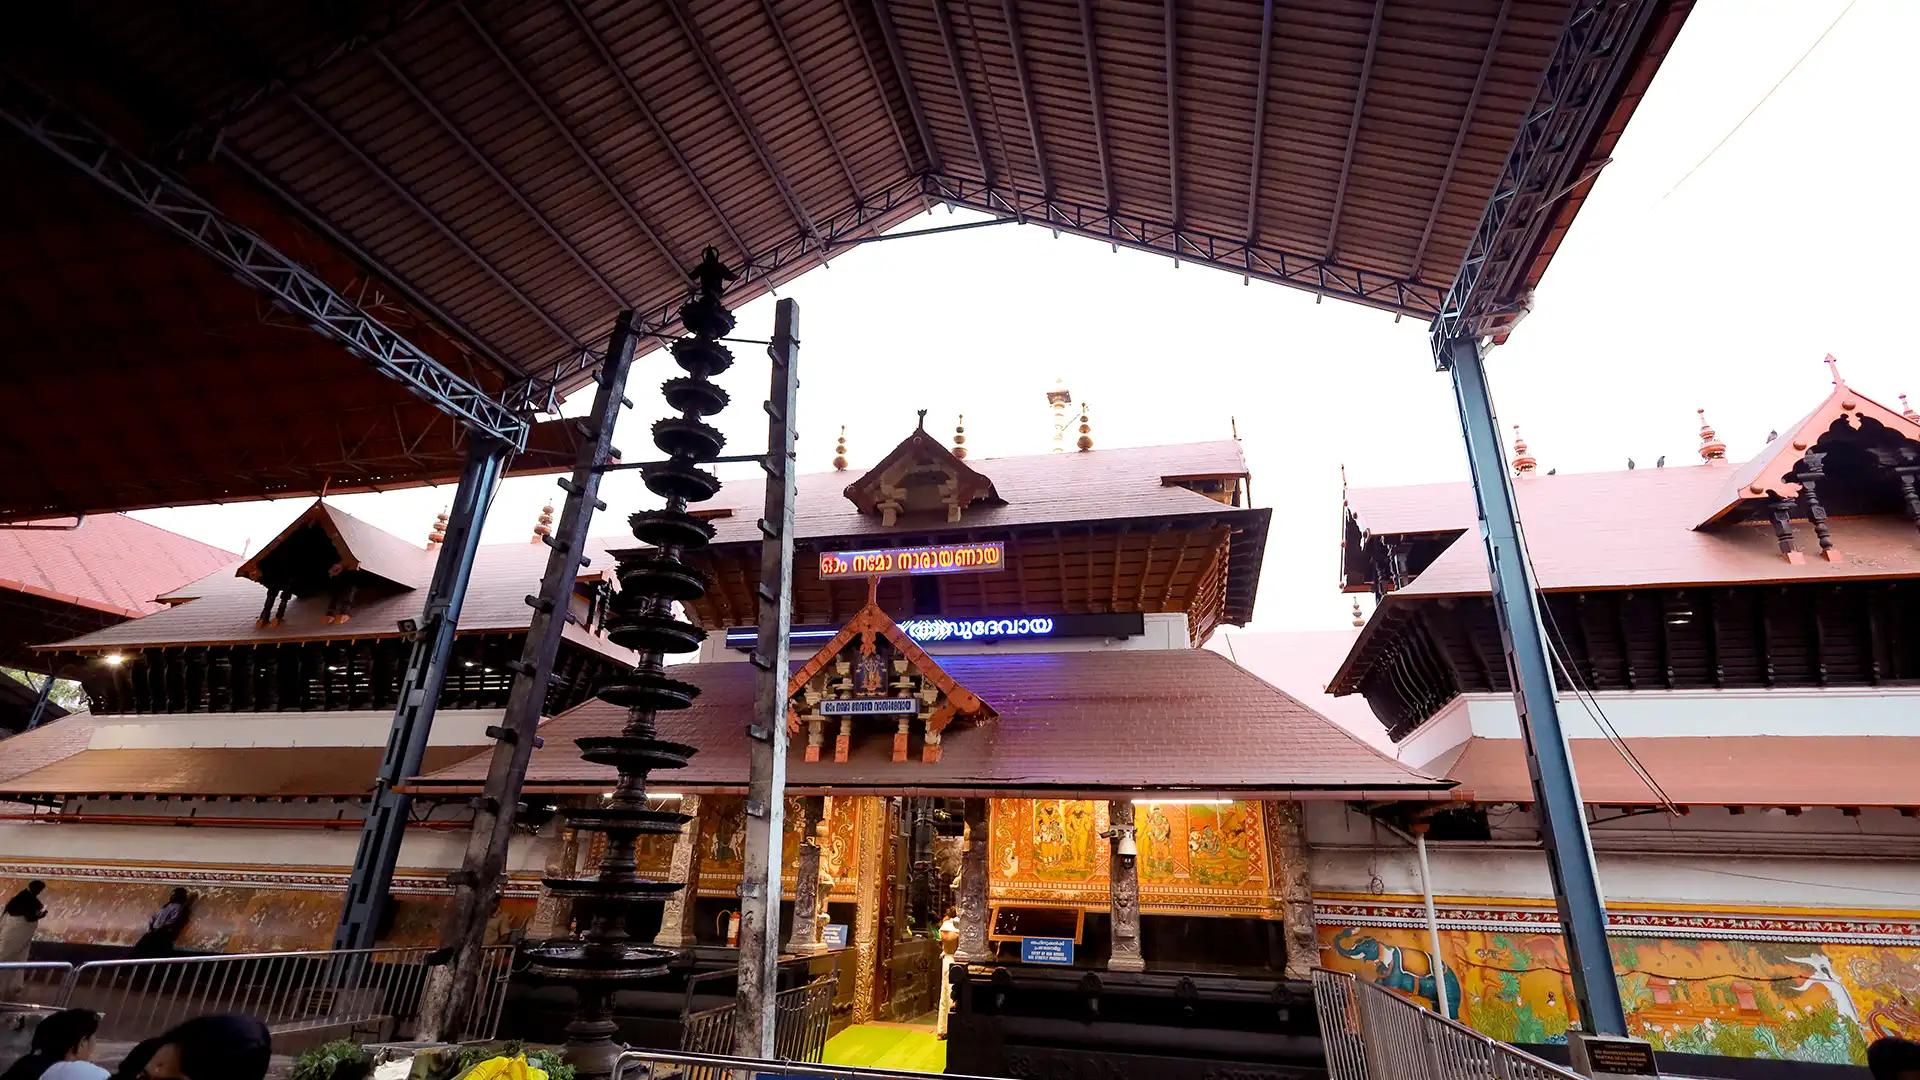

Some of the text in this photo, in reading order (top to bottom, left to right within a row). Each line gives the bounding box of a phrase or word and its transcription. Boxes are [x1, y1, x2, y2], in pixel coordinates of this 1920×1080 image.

[821, 547, 1000, 574] ഓം നമോ നാരായണായ
[908, 617, 1053, 640] സുദേവായ
